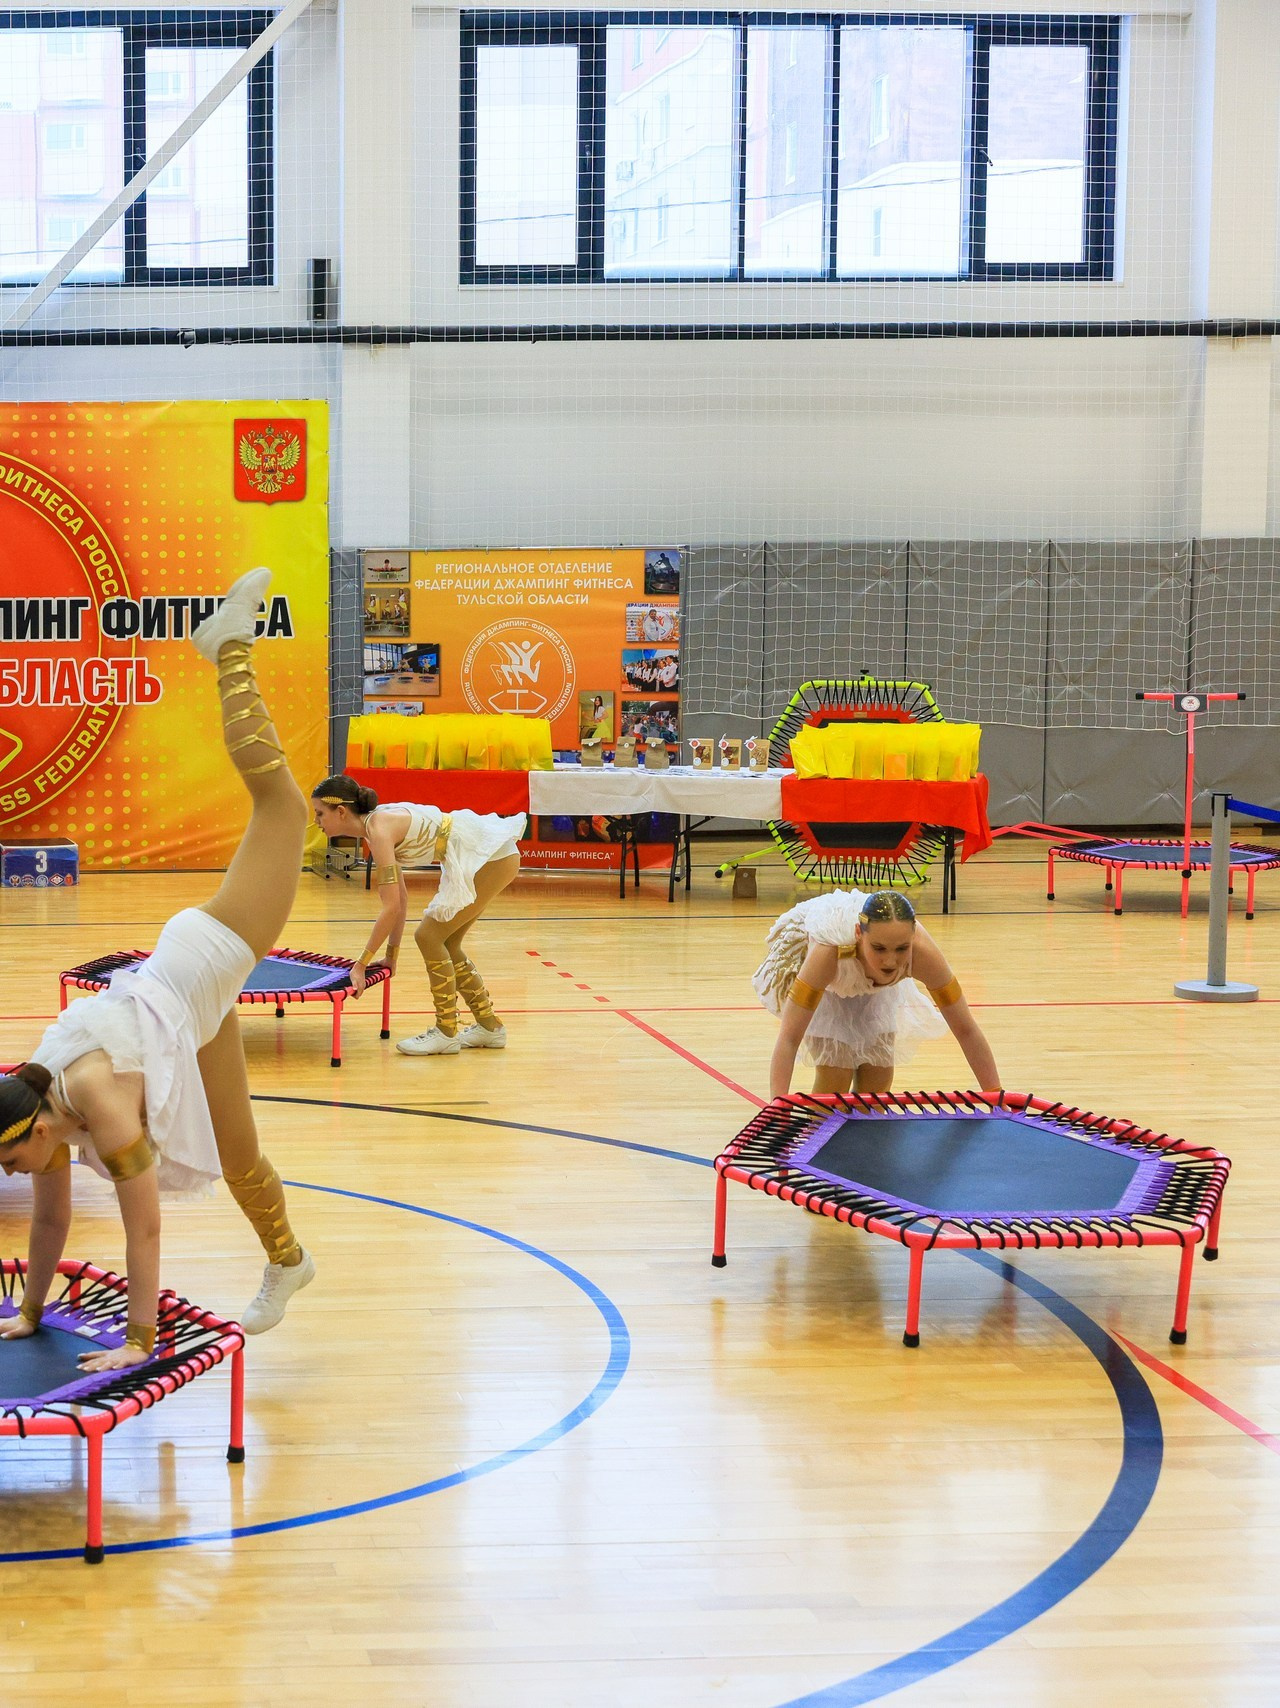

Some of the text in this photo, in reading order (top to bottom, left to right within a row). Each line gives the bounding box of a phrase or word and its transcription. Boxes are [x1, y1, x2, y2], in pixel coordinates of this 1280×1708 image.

[80, 534, 121, 600] РОСС
[414, 578, 634, 591] ФЕДЕРАЦИИ ДЖАМПИНГ ФИТНЕСА
[435, 561, 613, 576] РЕГИОНАЛЬНОЕ ОТДЕЛЕНИЕ
[100, 595, 295, 640] ФИТНСА
[456, 592, 589, 605] ТУЛЬСКОЙ ОБЛАСТИ
[463, 634, 487, 674] ФЕДЕРАЦИЯ
[559, 645, 573, 674] РОССИИ
[464, 681, 572, 720] RUSSIAN FEDERATION
[33, 692, 115, 794] FEDERAT
[34, 850, 48, 873] 3
